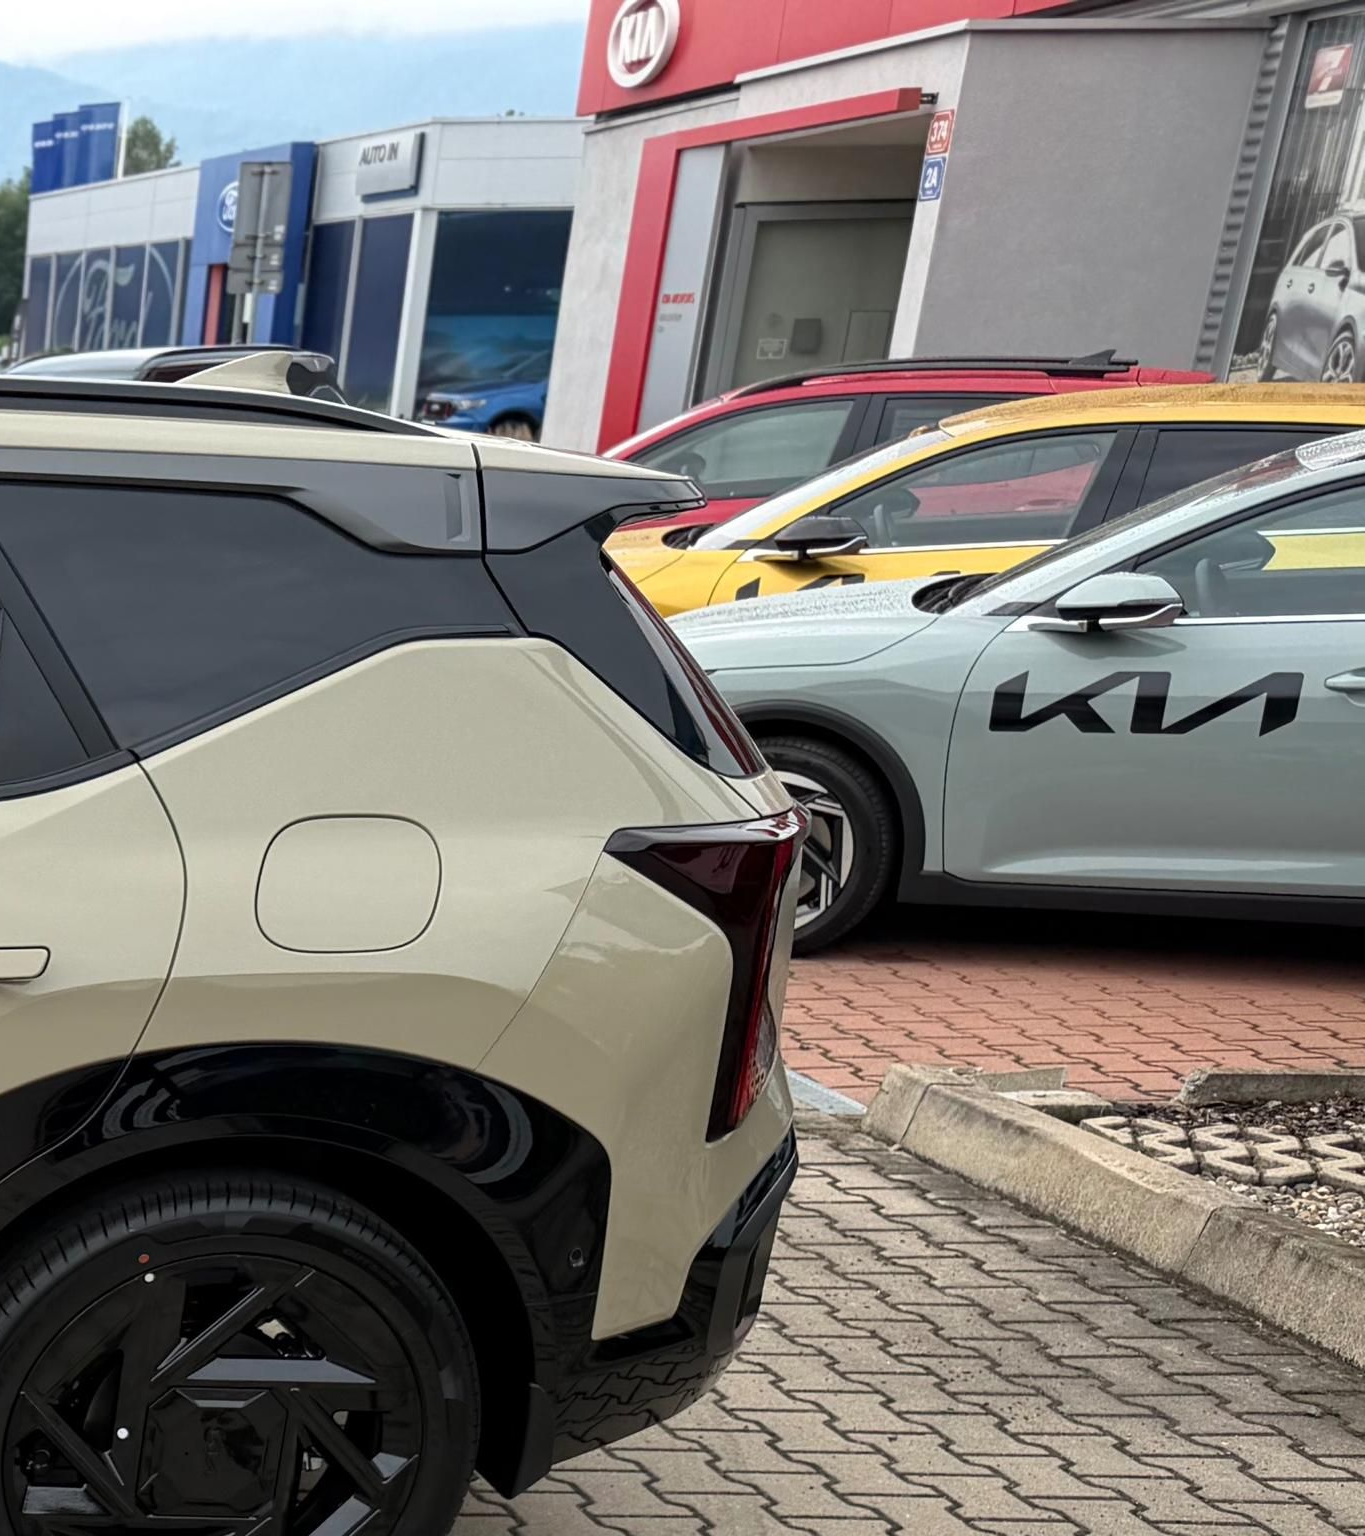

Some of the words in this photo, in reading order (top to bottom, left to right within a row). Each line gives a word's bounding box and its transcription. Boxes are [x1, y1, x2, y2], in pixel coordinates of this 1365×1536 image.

[617, 7, 658, 65] KIA
[930, 120, 949, 142] 374
[359, 144, 386, 166] AUTO
[387, 141, 399, 161] IN
[988, 670, 1305, 737] KIA
